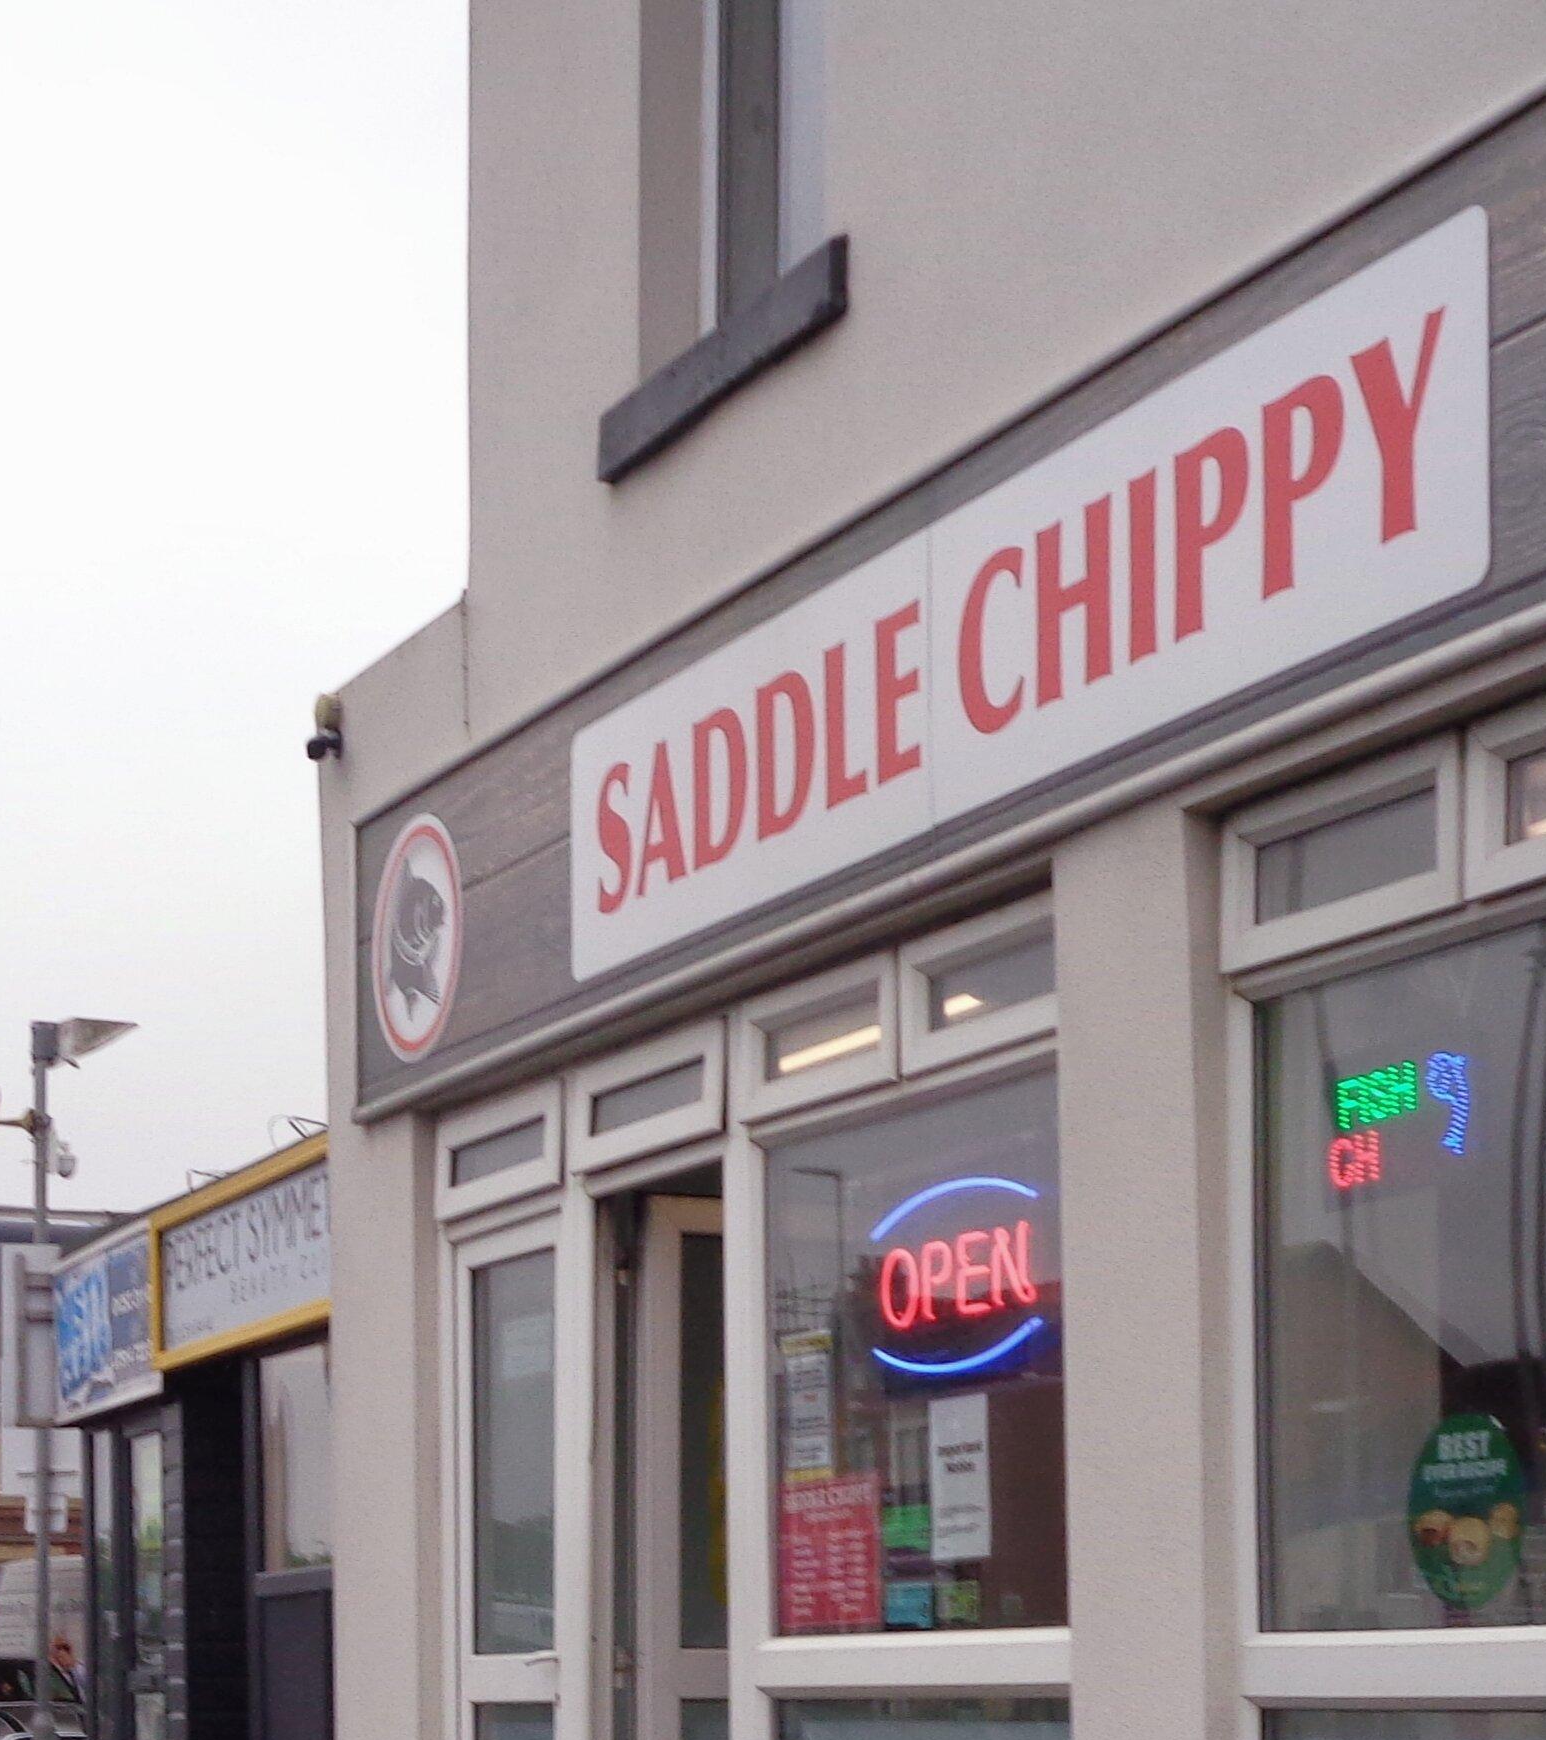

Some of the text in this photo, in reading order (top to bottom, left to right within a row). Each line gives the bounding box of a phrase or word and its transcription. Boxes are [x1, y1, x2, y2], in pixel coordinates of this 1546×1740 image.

[595, 305, 1446, 914] SADDLE CHIPPY
[877, 1219, 1039, 1332] OPEN
[1437, 1430, 1490, 1461] BEST
